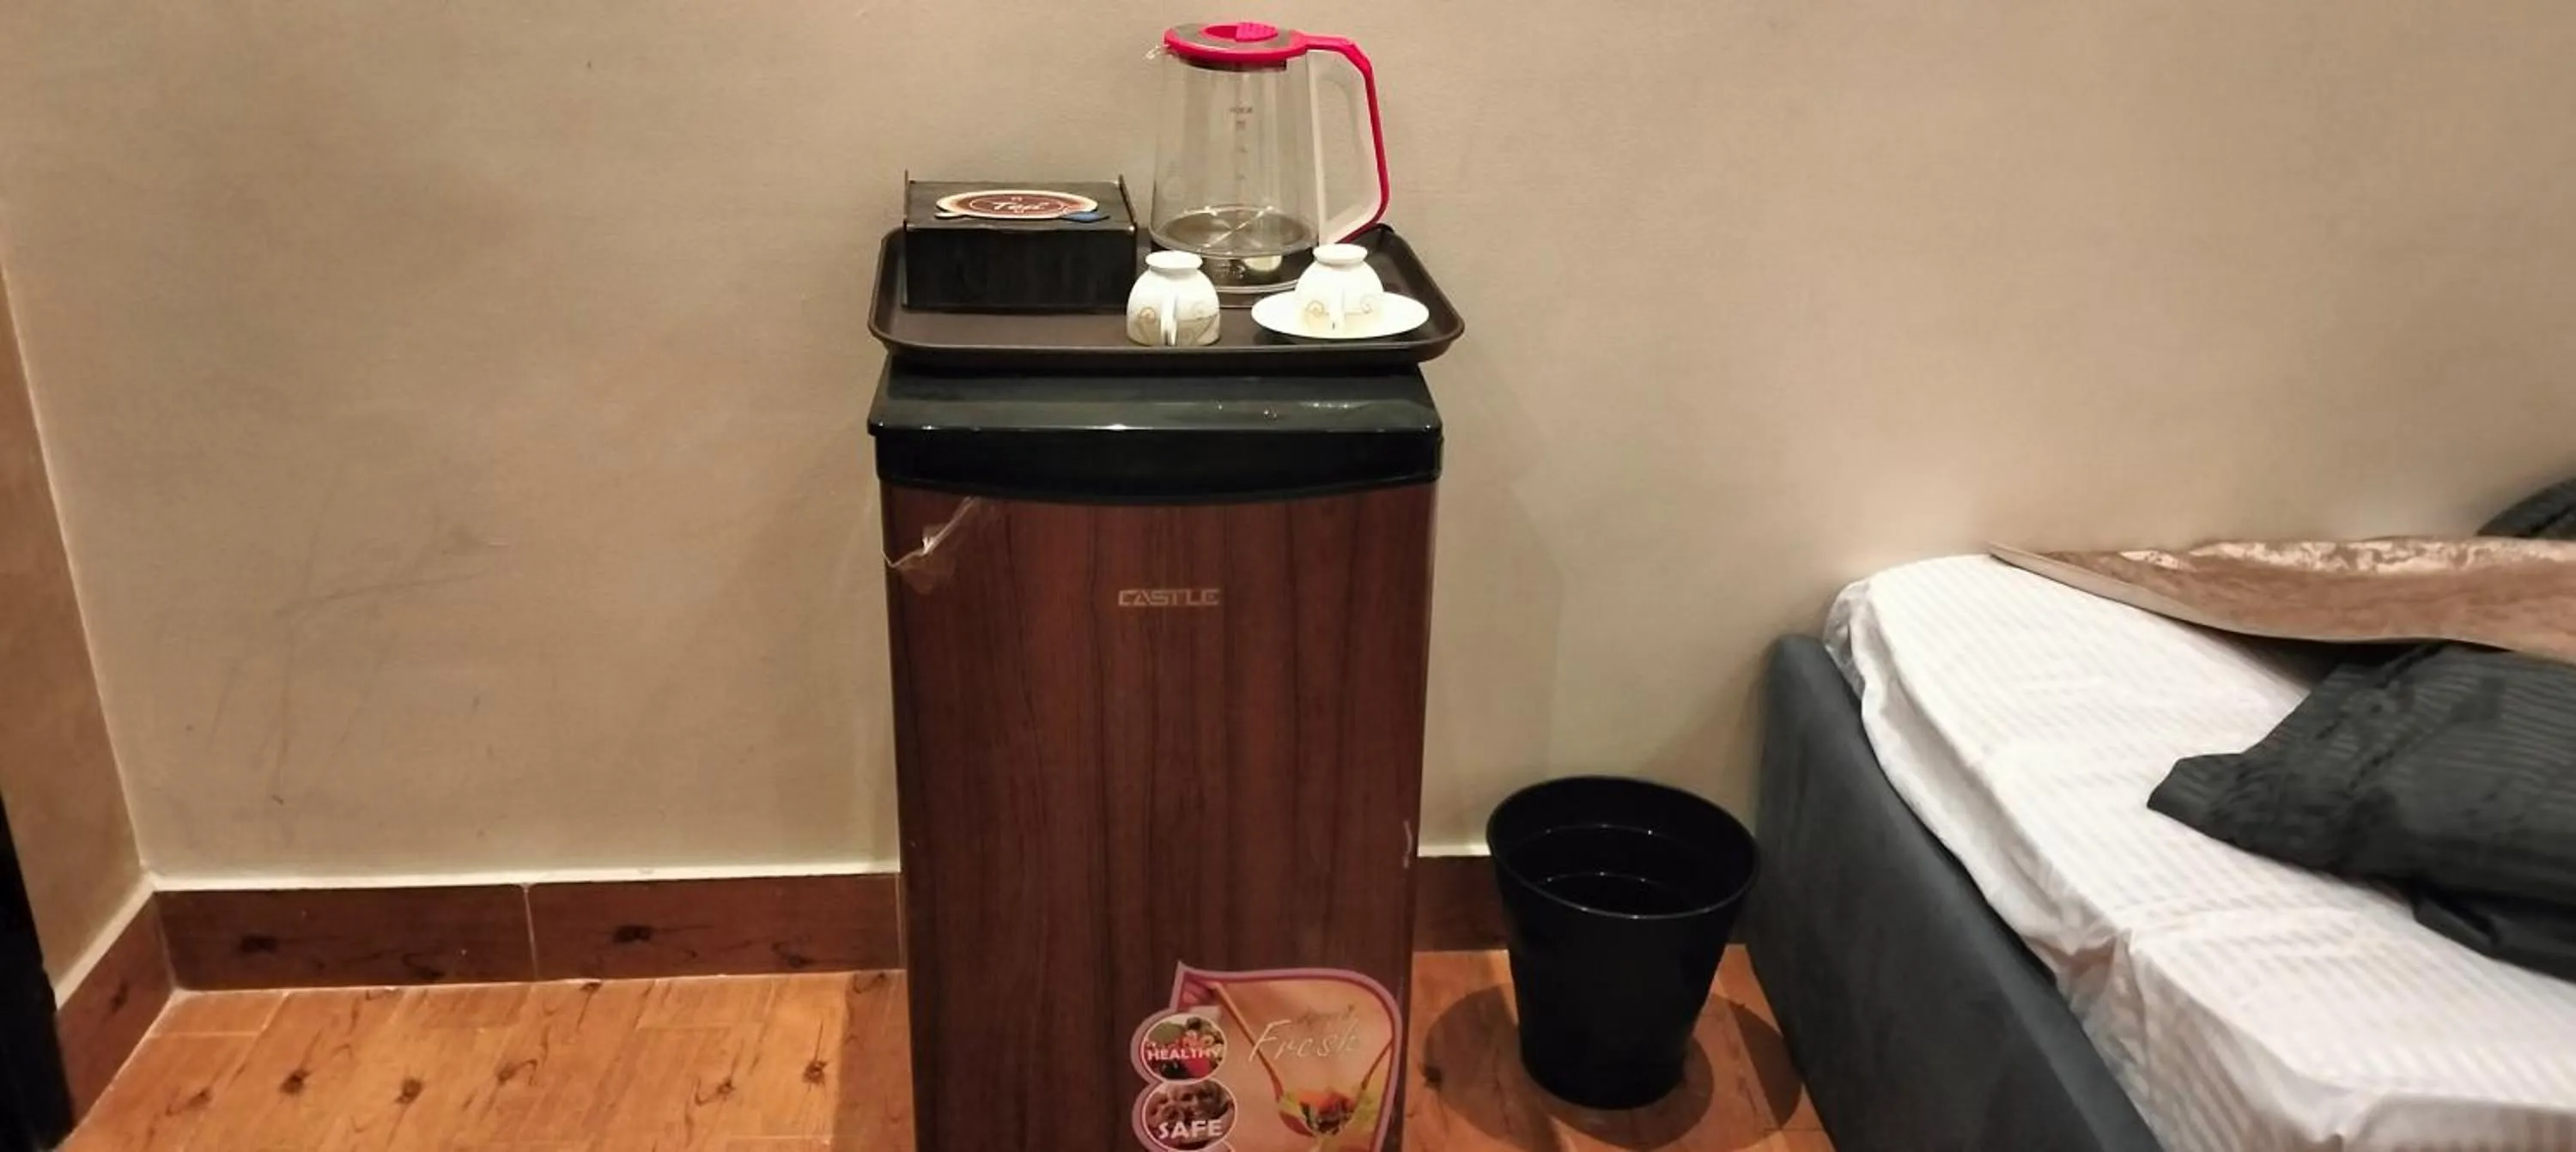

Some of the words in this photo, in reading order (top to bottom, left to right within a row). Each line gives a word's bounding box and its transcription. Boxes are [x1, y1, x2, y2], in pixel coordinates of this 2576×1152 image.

[1117, 589, 1219, 605] CASTLE
[1248, 1017, 1360, 1063] Fresh
[1146, 1048, 1222, 1060] HEALTHY
[1158, 1119, 1223, 1139] SAFE
